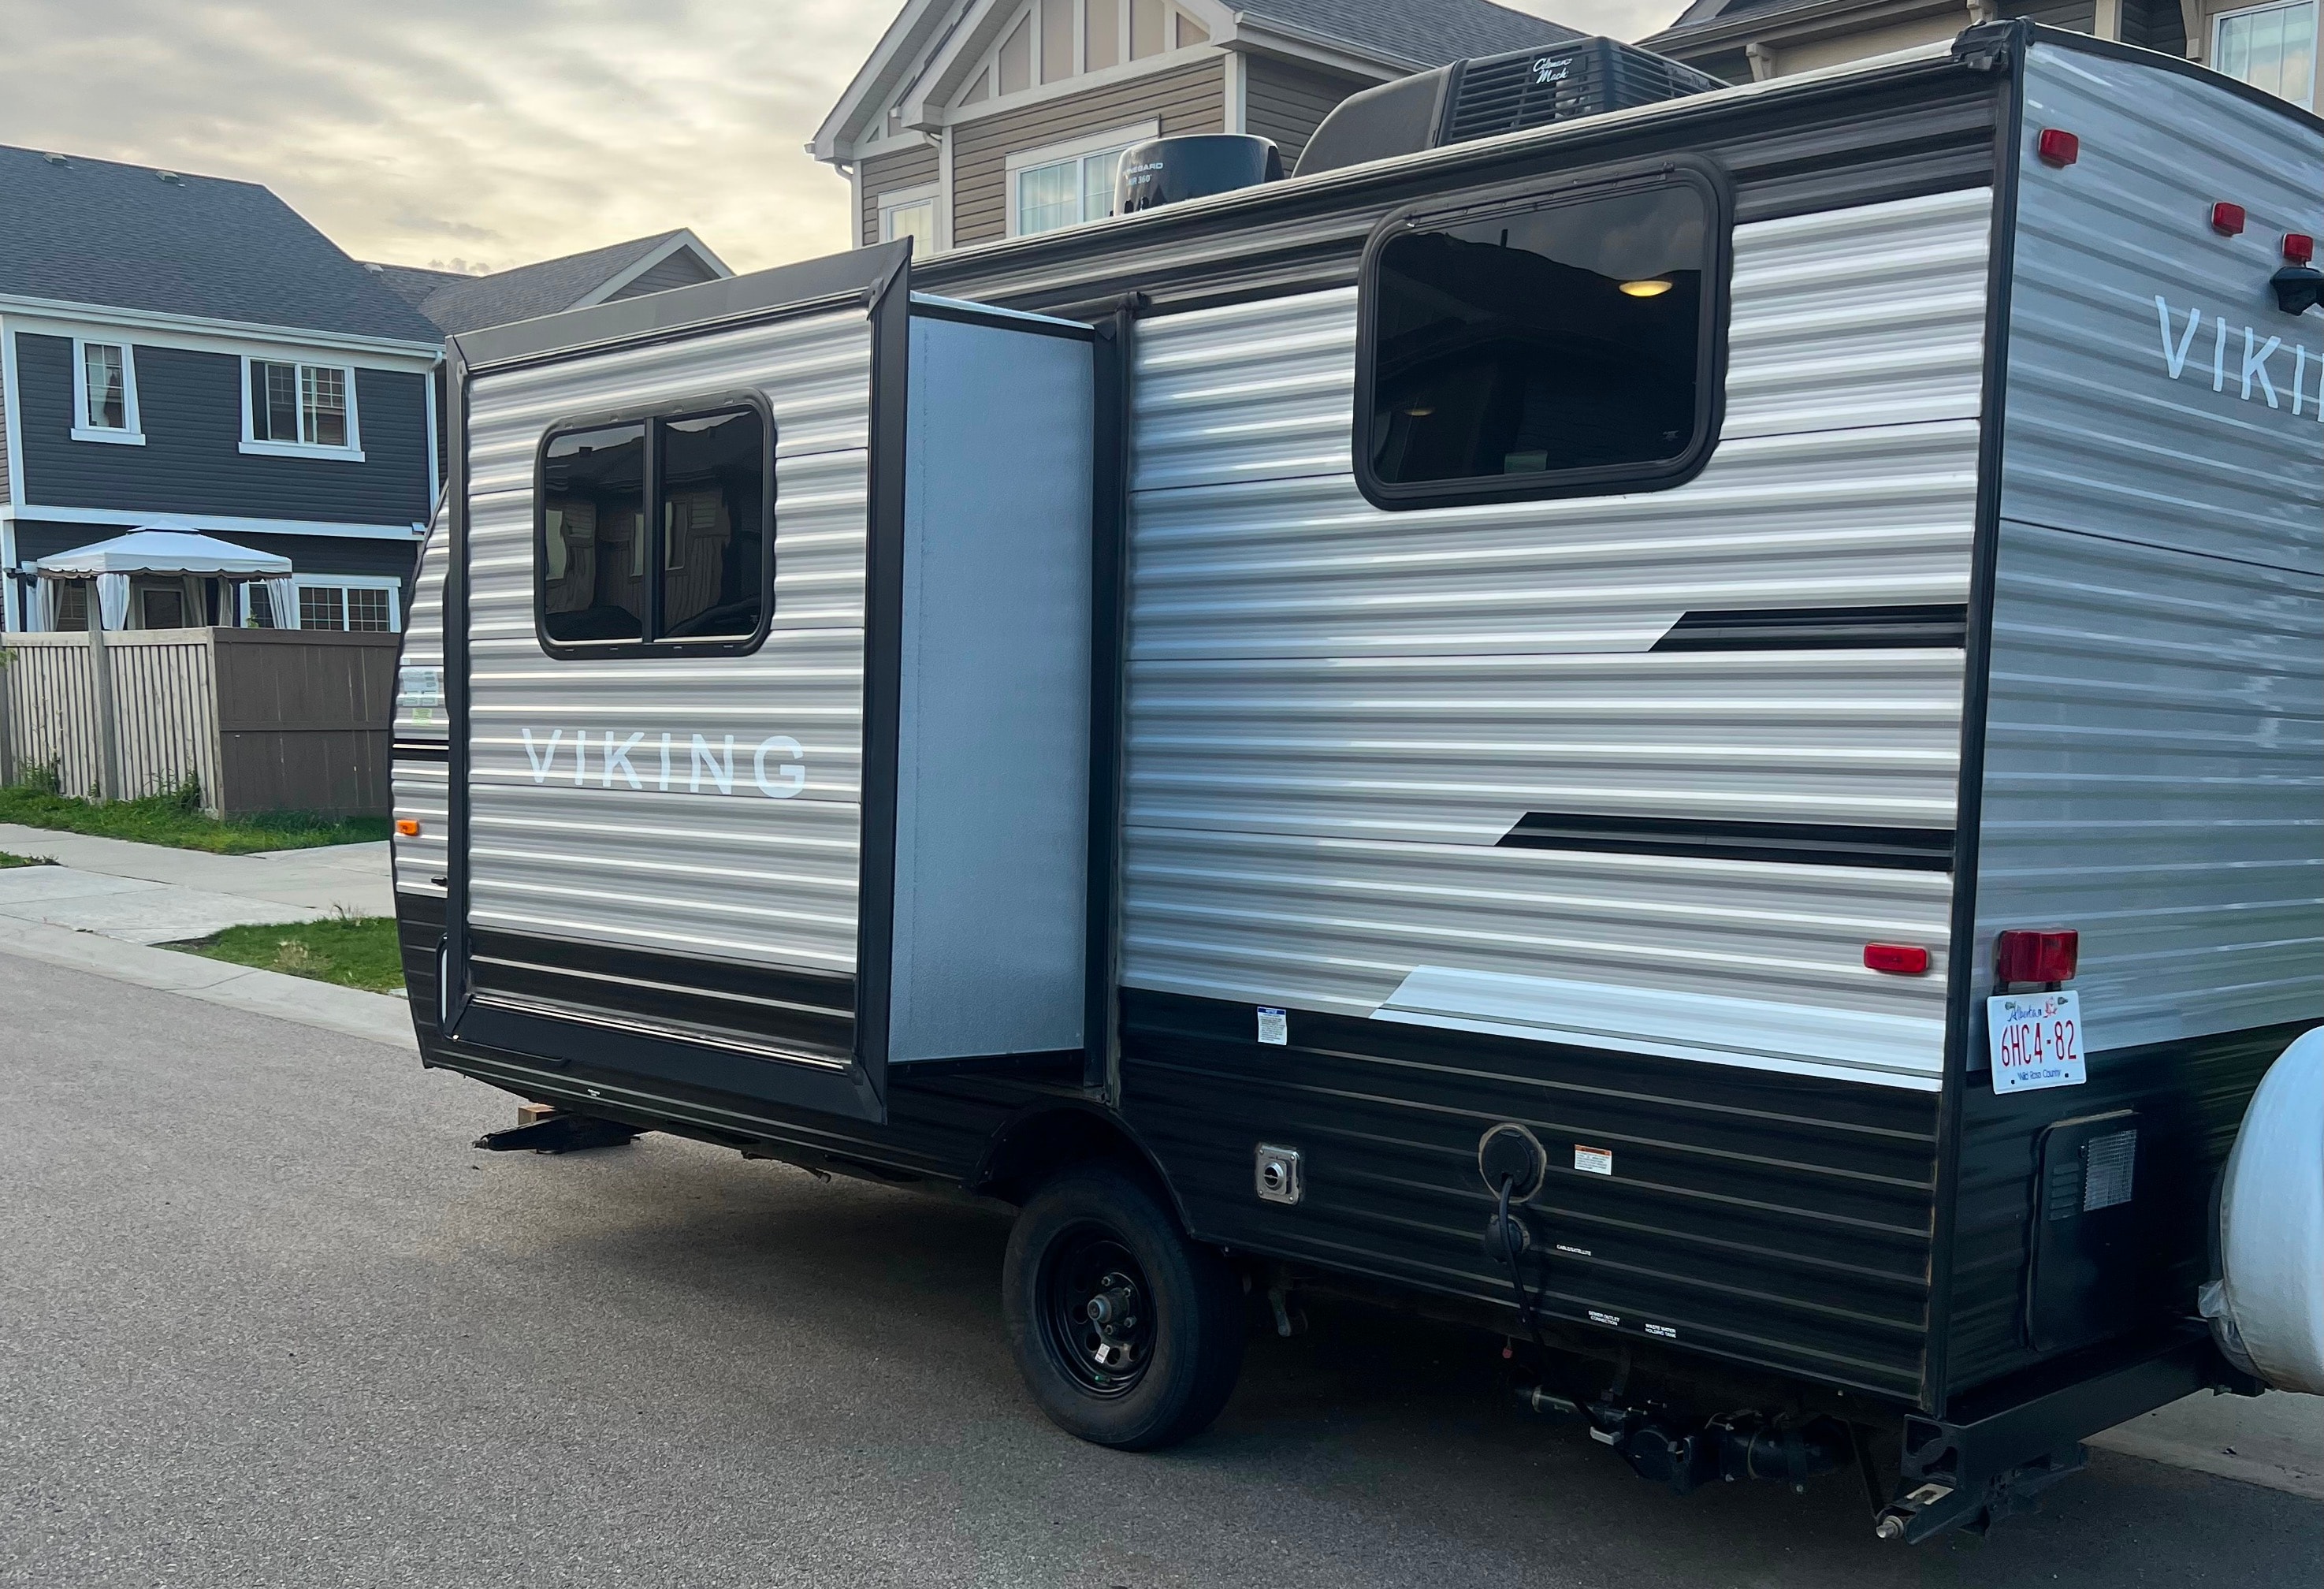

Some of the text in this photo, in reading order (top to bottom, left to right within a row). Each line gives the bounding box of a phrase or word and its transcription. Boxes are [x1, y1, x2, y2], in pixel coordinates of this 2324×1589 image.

[2155, 295, 2324, 423] VIKI
[522, 728, 805, 798] VIKING
[2002, 1020, 2077, 1066] 6HC4-82
